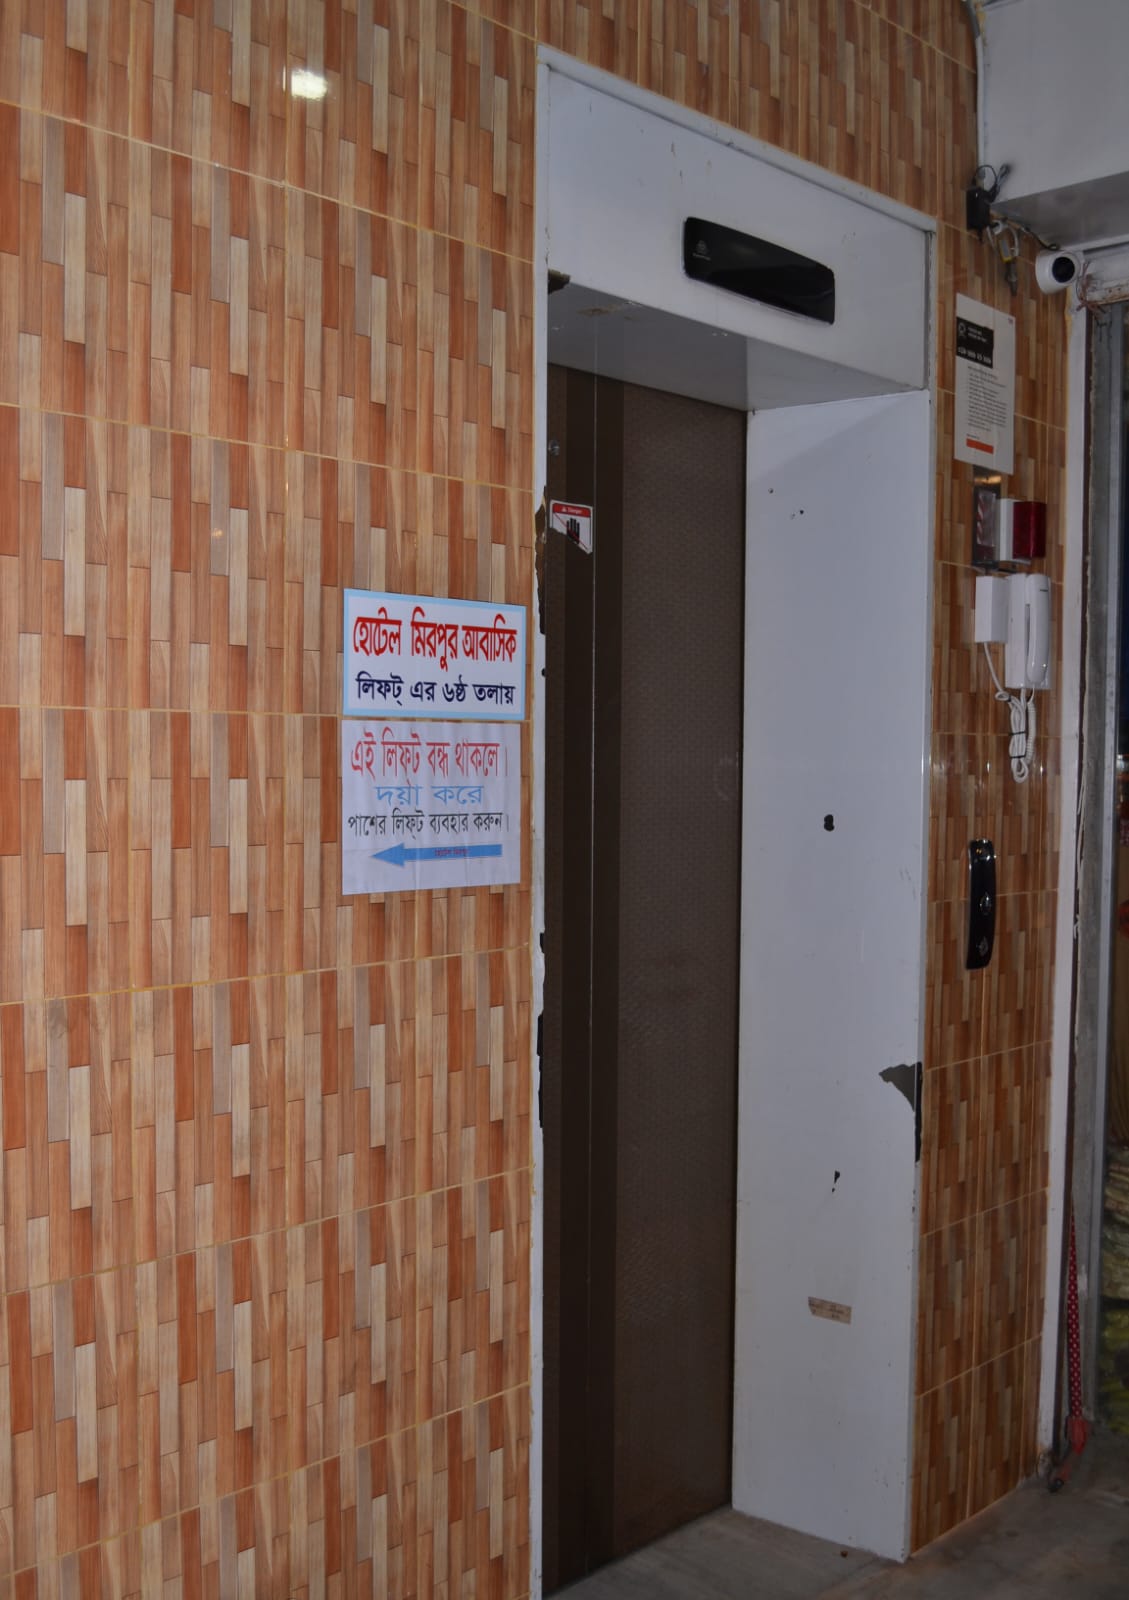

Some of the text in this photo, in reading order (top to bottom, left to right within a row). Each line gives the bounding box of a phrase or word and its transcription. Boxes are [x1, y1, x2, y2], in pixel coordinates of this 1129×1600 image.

[353, 606, 517, 672] হোটেল মিরপুর আবাসিক
[410, 680, 437, 702] এর
[442, 674, 468, 703] ৬ষ্ঠ
[472, 682, 516, 705] তলায়
[351, 727, 376, 782] এই
[426, 742, 451, 778] বন্ধ
[374, 784, 484, 806] দয়া করে
[347, 812, 387, 837] পাশের
[429, 812, 469, 835] ব্যবহার
